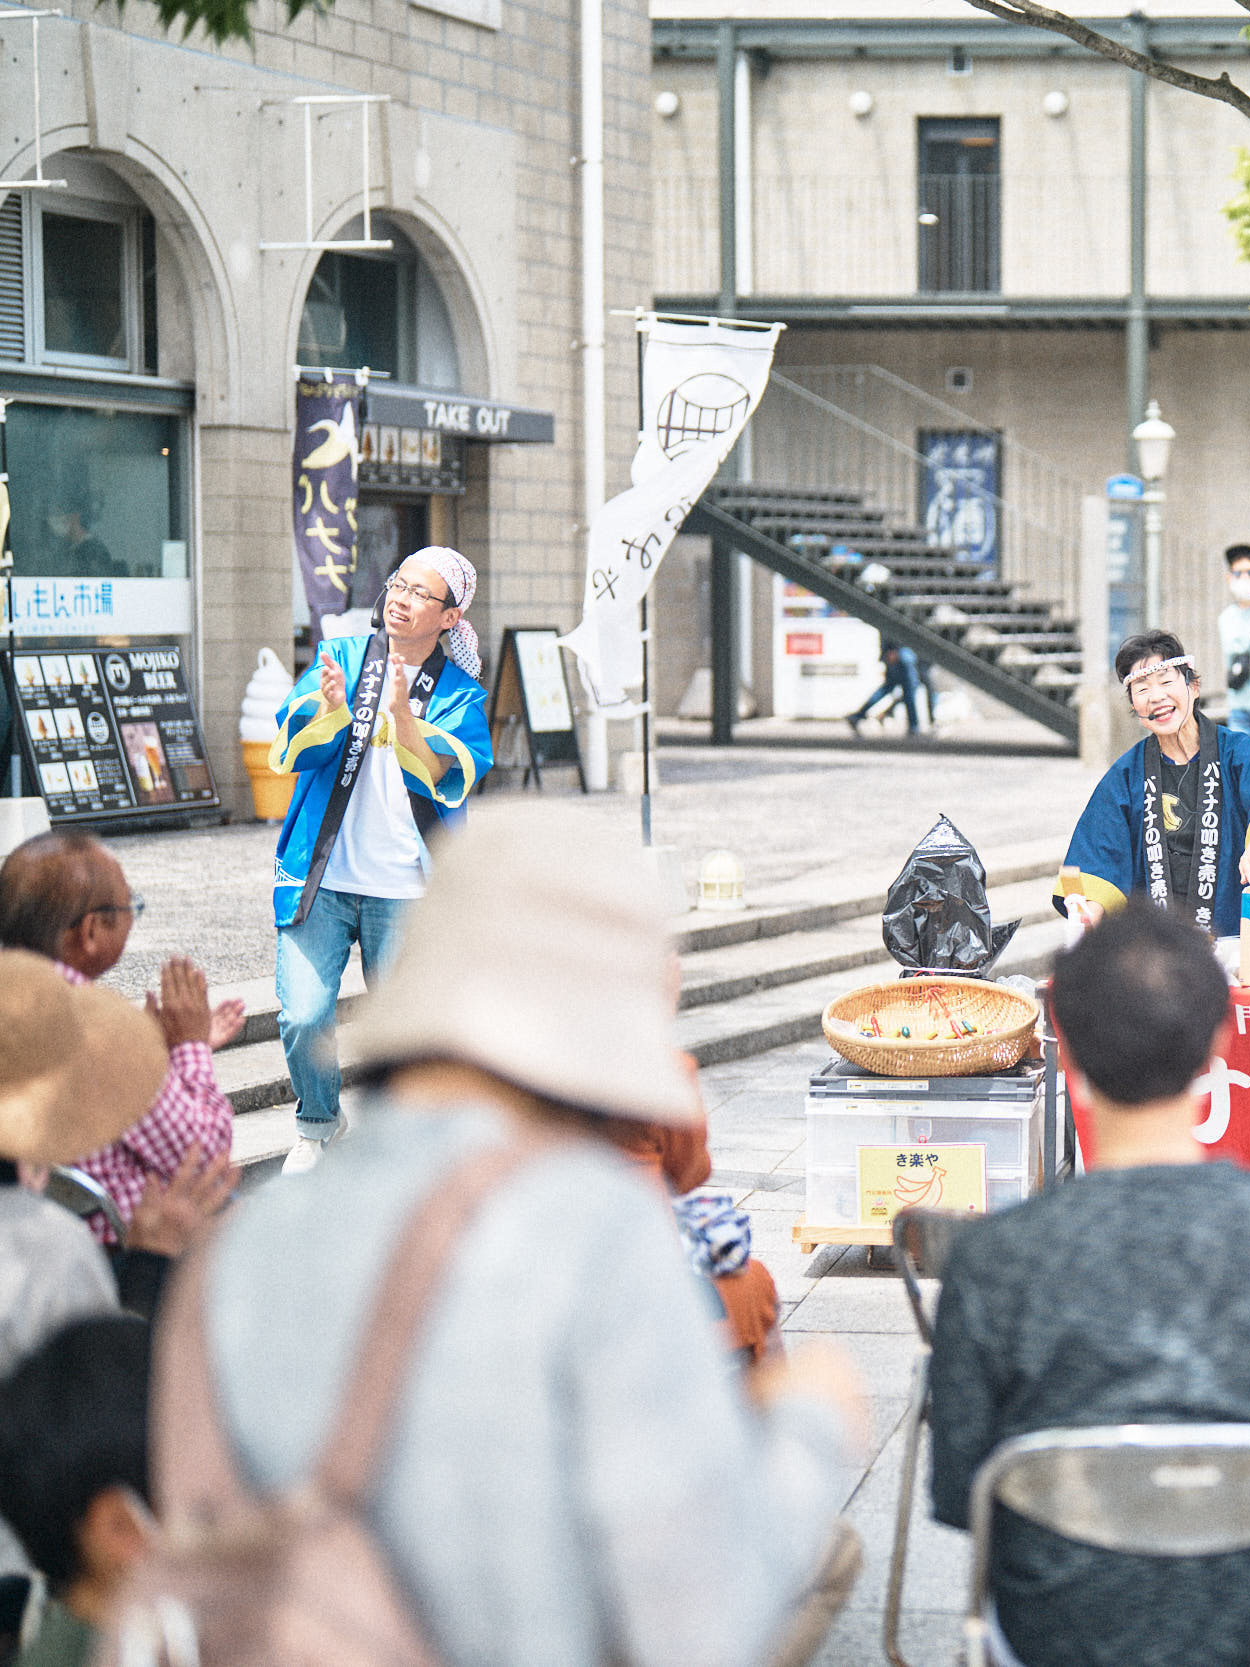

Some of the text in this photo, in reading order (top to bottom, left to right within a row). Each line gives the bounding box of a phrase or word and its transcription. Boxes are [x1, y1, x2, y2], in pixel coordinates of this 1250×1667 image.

[424, 401, 511, 435] TAKE OUT
[340, 659, 384, 787] バナナの叩き売り
[1197, 761, 1221, 900] バナナの叩き売り
[896, 1153, 939, 1168] き楽や
